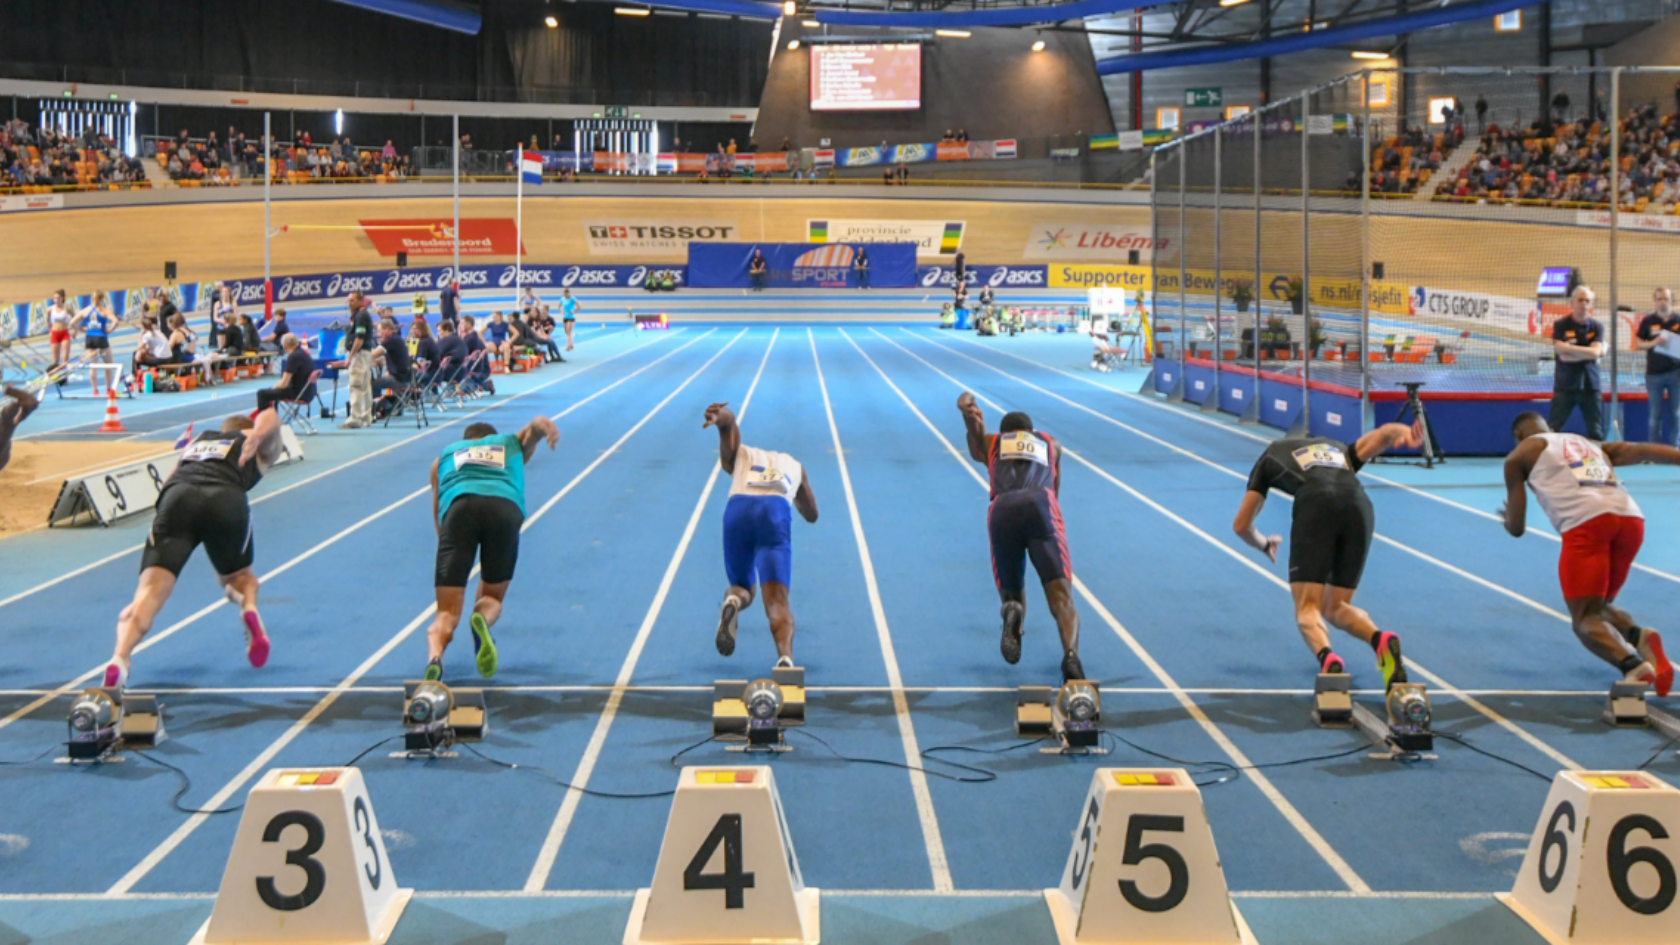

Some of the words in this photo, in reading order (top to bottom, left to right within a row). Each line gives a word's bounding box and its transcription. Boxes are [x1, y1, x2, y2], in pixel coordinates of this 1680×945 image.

[629, 226, 733, 239] TISSOT
[847, 225, 911, 236] provincie
[341, 276, 373, 292] asics
[398, 273, 432, 288] asics
[579, 269, 616, 284] asics
[1006, 270, 1043, 284] asics
[1063, 267, 1145, 286] Supporter
[242, 284, 266, 300] asic
[291, 281, 322, 296] asics
[1321, 283, 1402, 307] ns.nl/risjefit
[1429, 291, 1449, 314] CTS
[1452, 296, 1489, 318] GROUP
[1015, 440, 1035, 454] 90
[105, 474, 127, 511] 9
[354, 796, 382, 891] 3
[1072, 797, 1099, 890] 5
[1539, 800, 1576, 894] 6
[255, 810, 327, 912] 3
[683, 813, 755, 909] 4
[1117, 813, 1190, 914] 5
[1606, 813, 1678, 916] 6
